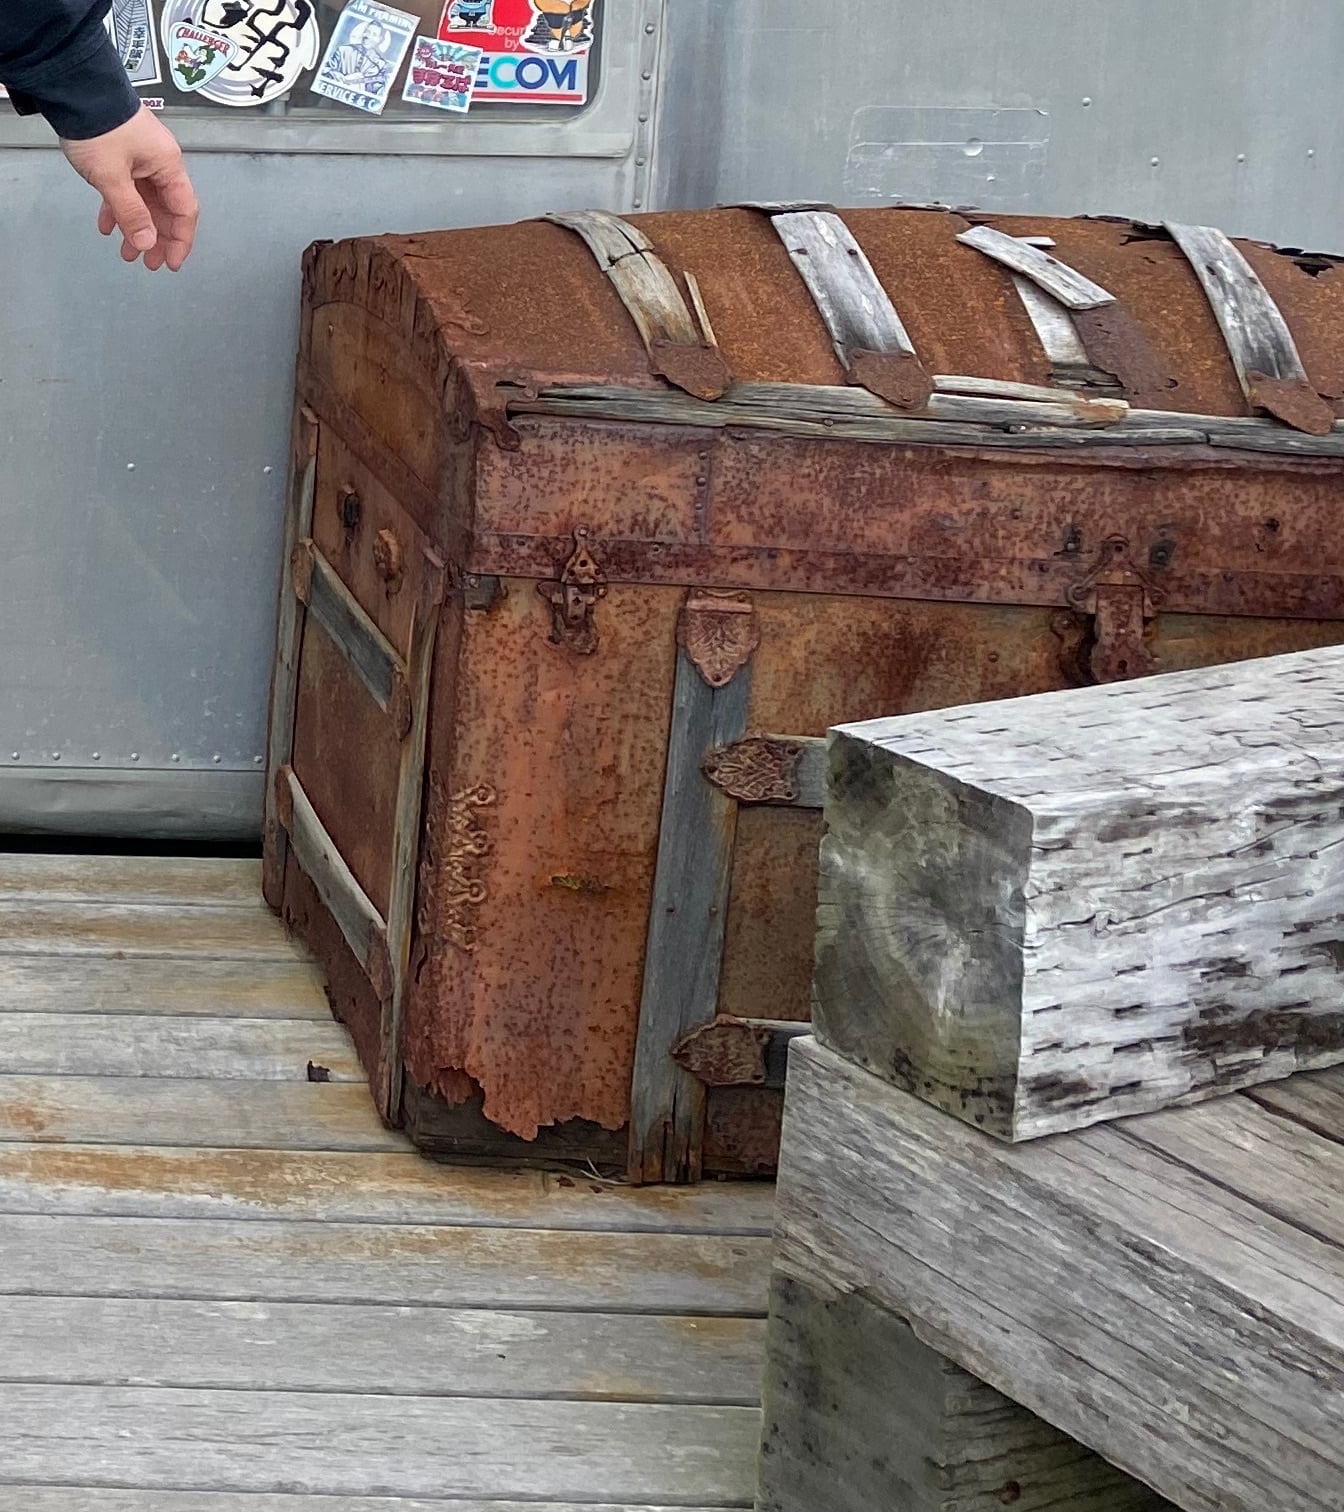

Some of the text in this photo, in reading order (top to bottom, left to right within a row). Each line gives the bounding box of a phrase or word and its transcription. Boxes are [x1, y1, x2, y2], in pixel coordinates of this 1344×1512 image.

[488, 25, 526, 36] ecur
[504, 37, 519, 51] by
[474, 56, 578, 91] ECOM
[318, 82, 355, 104] ERVICE
